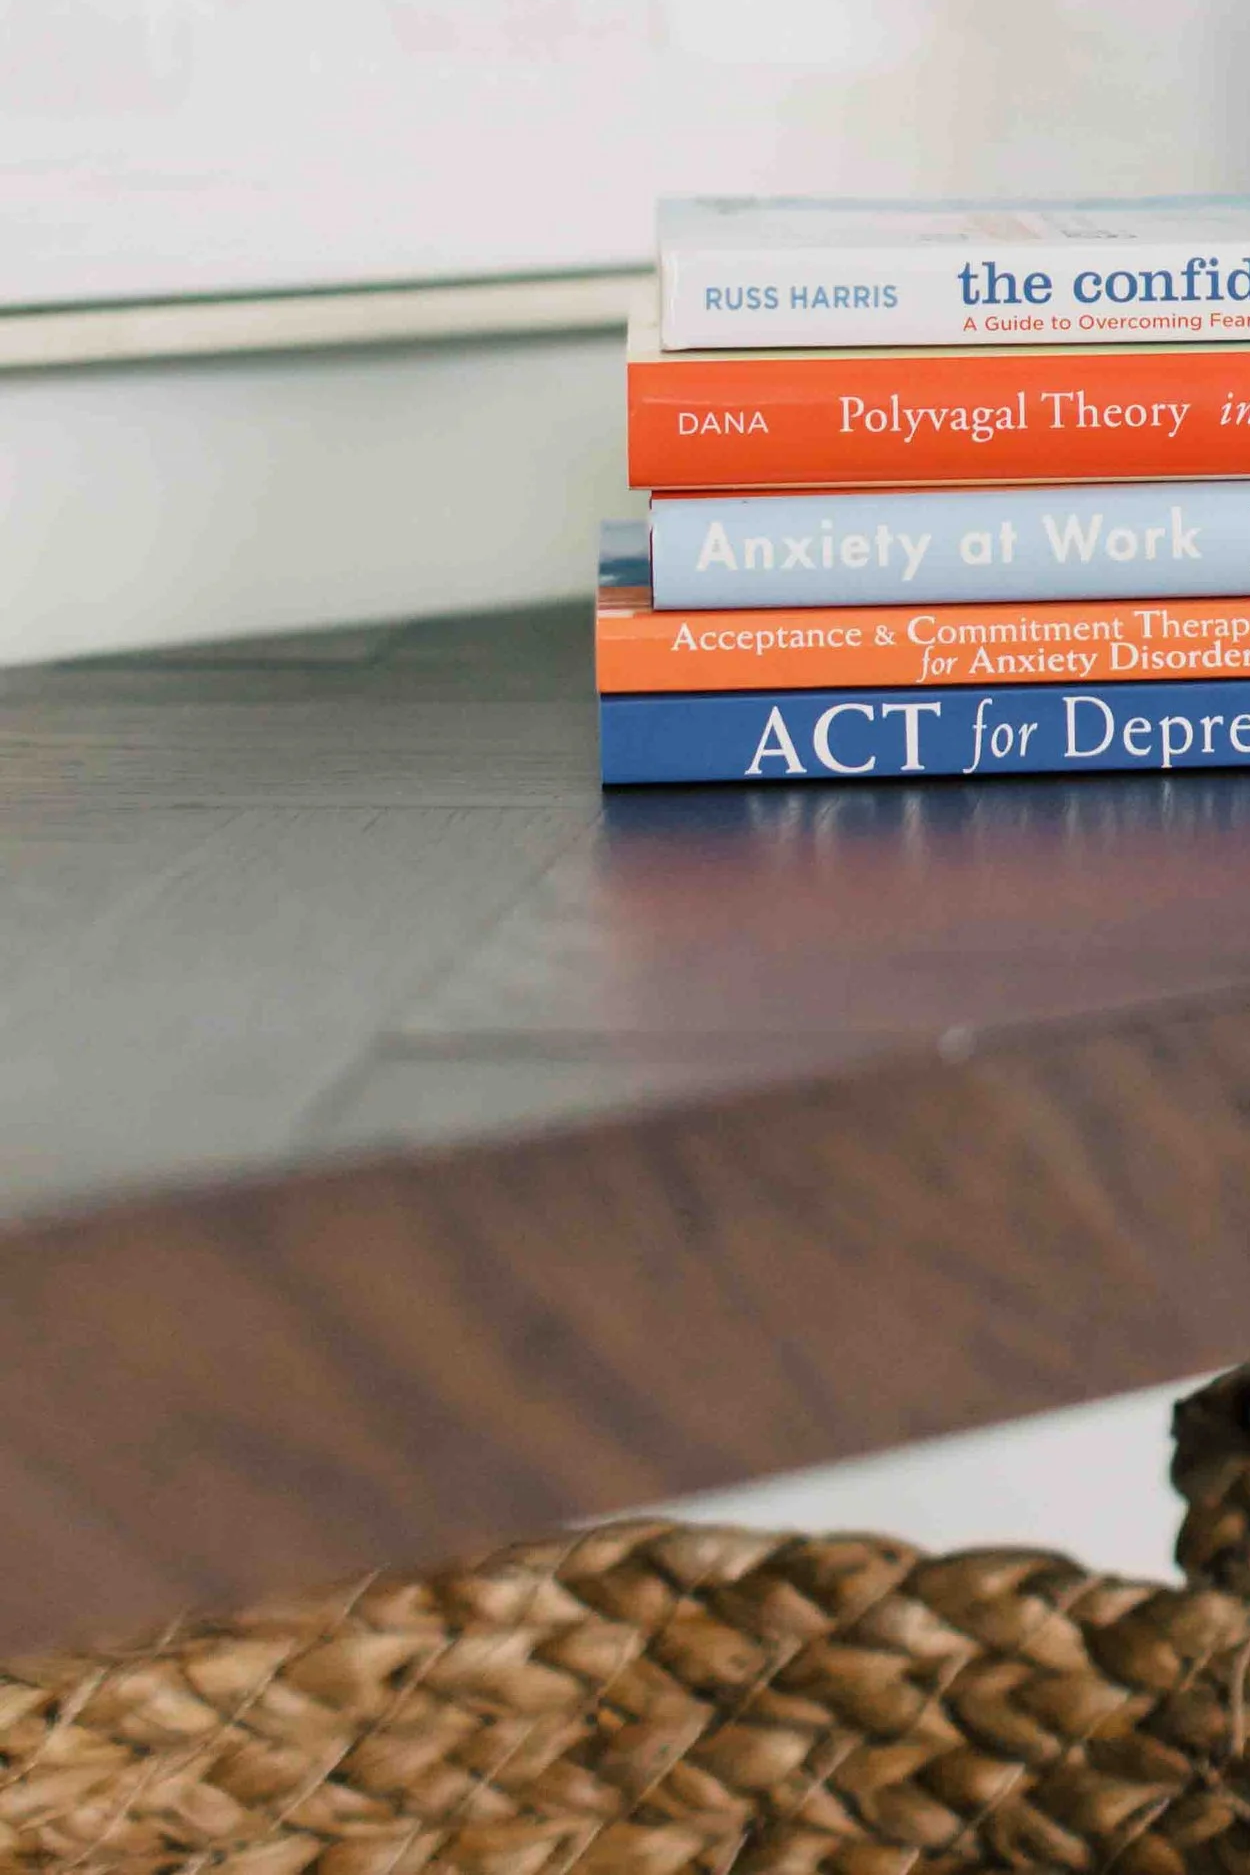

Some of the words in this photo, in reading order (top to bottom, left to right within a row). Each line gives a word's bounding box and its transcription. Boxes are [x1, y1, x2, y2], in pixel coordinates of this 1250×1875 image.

[706, 286, 778, 310] RUSS
[791, 285, 898, 309] HARRIS
[958, 261, 1052, 305] the
[963, 316, 978, 331] A
[985, 315, 1044, 332] Guide
[1051, 316, 1071, 330] to
[1079, 314, 1202, 331] Overcoming
[678, 411, 769, 436] DANA
[839, 390, 1028, 443] Polyvagal
[1040, 390, 1191, 437] Theory
[695, 518, 932, 582] Anxiety
[959, 521, 1017, 566] at
[1042, 506, 1202, 563] Work
[671, 622, 862, 655] Acceptance
[874, 625, 896, 645] &
[907, 615, 1124, 644] Commitment
[916, 646, 958, 683] for
[969, 646, 1098, 677] Anxiety
[744, 702, 941, 774] ACT
[963, 698, 1037, 774] for
